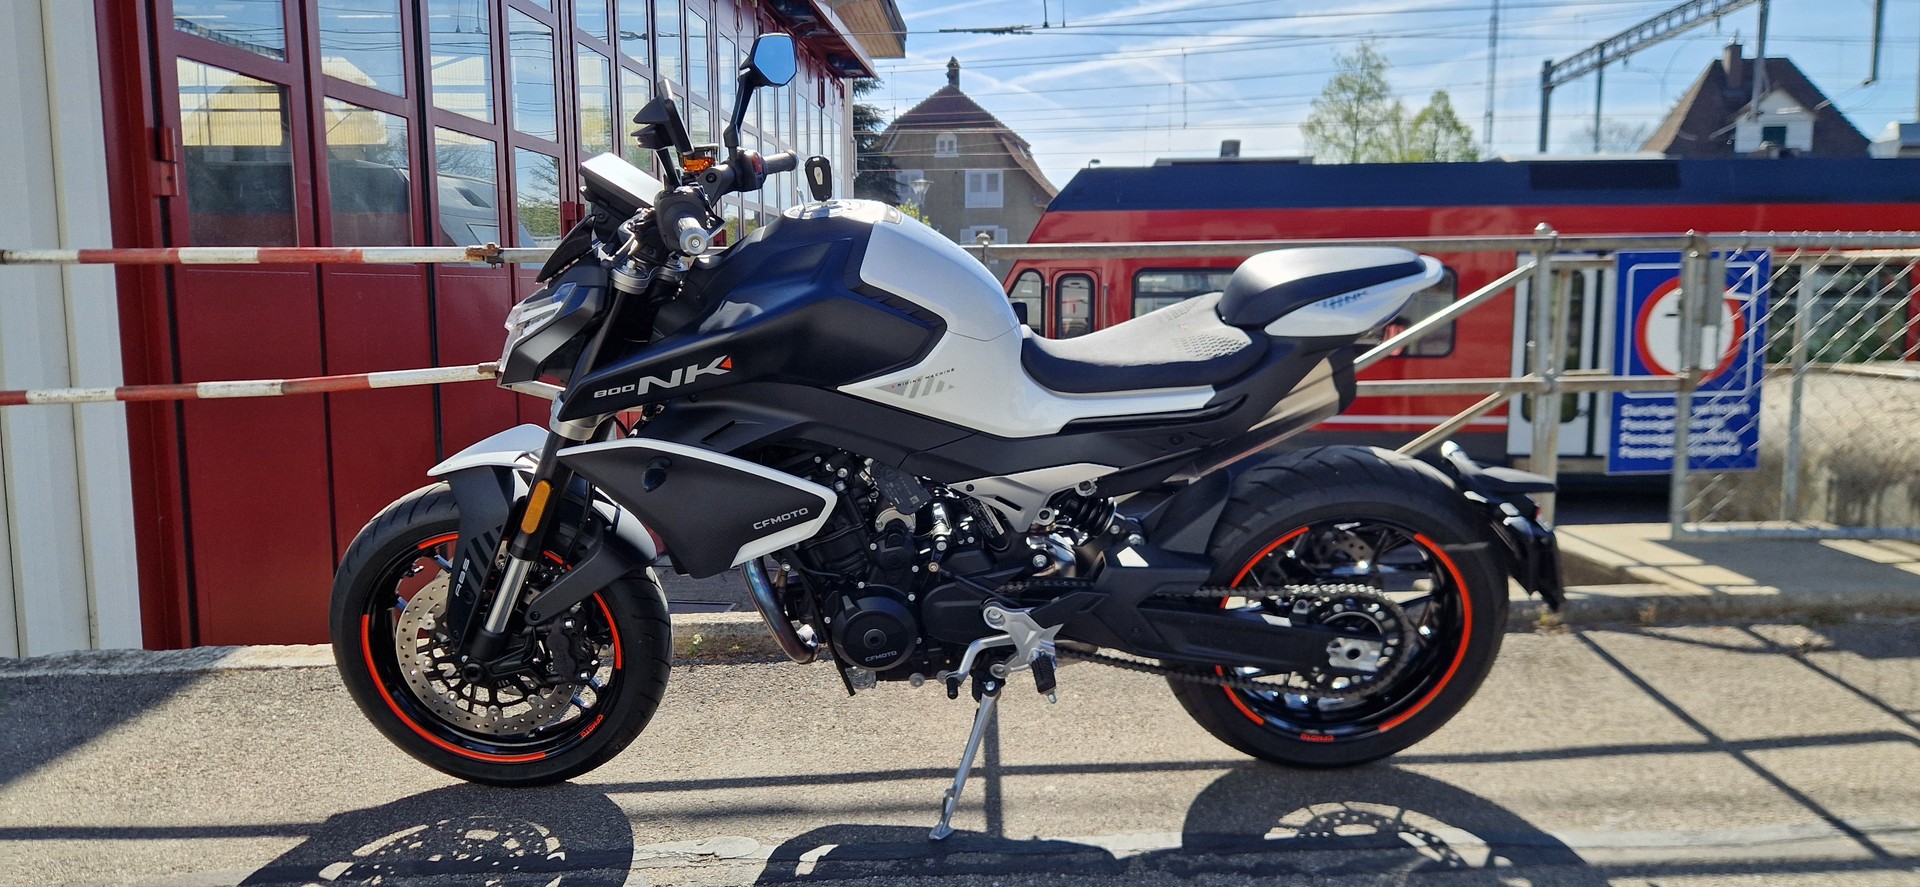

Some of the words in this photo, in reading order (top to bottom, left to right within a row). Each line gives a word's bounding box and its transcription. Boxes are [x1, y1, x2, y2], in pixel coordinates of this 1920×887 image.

[593, 383, 636, 398] 800
[637, 354, 732, 396] NK
[897, 377, 922, 387] RIDING
[925, 367, 955, 380] MACHINE
[753, 507, 809, 530] CFMOTO
[454, 557, 470, 597] ABS
[865, 650, 897, 662] CFMOTO
